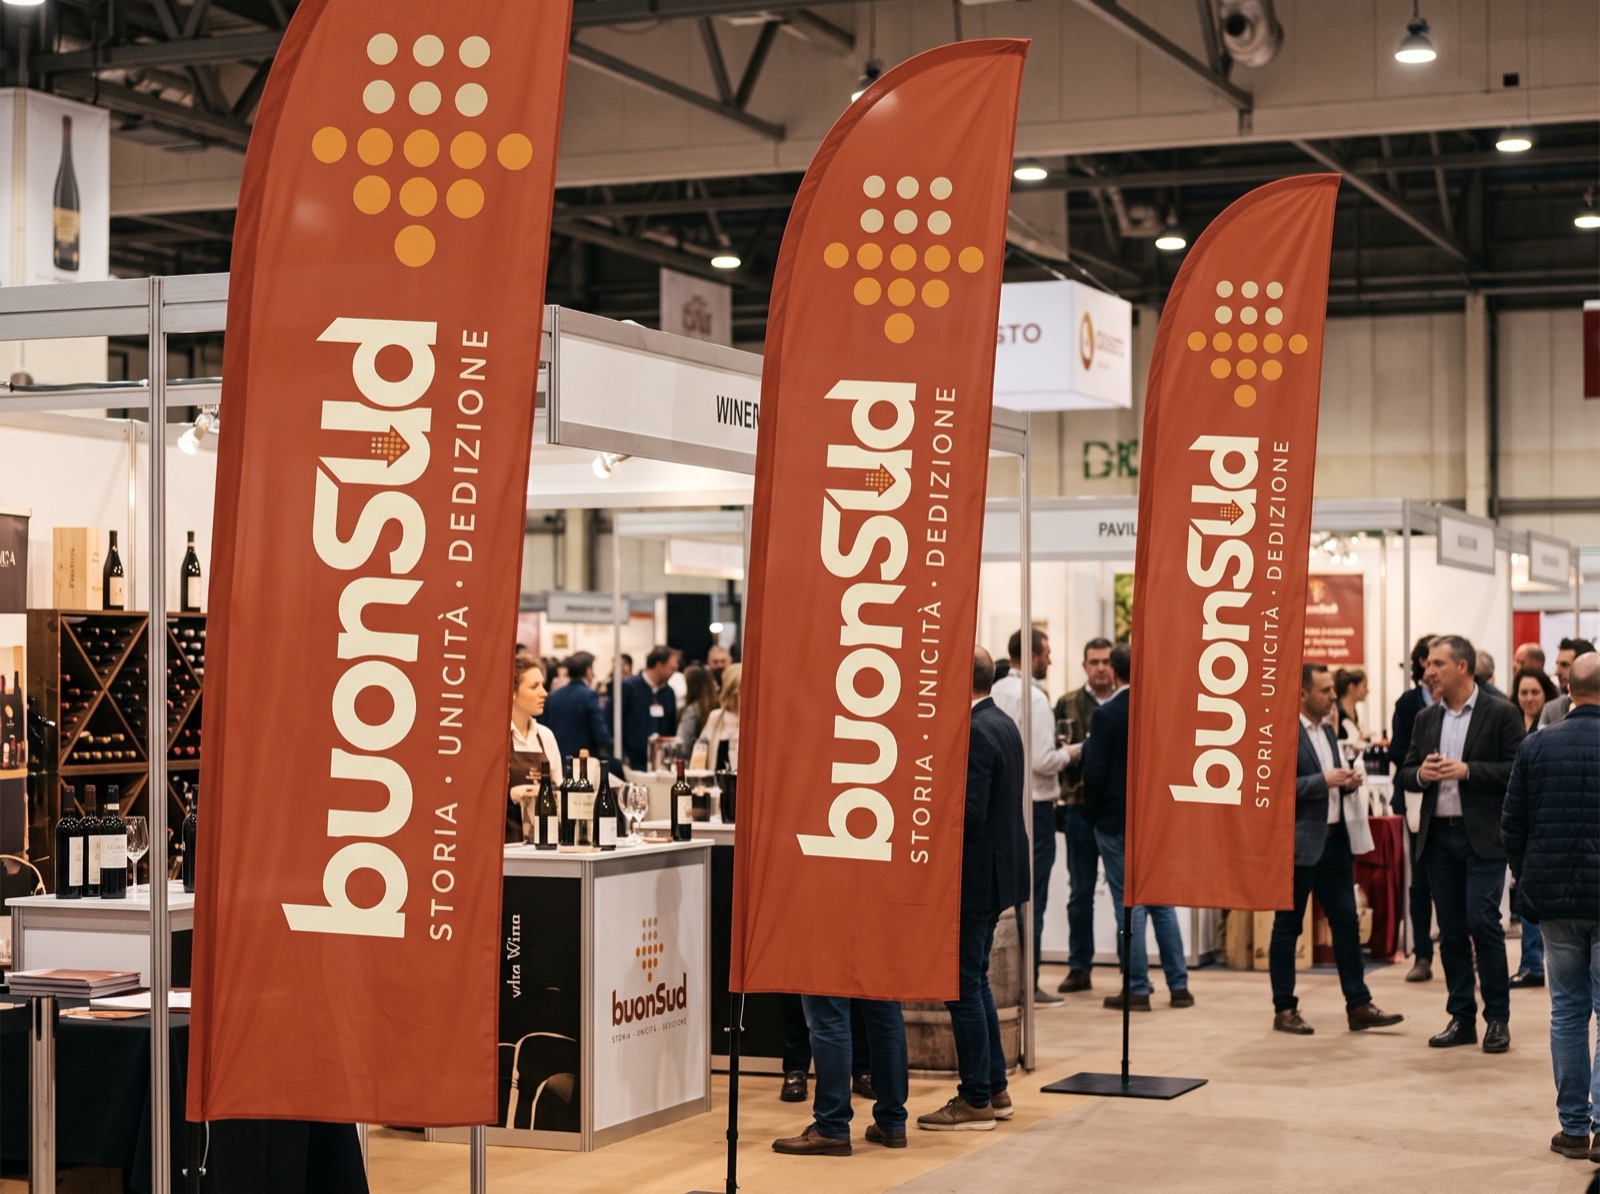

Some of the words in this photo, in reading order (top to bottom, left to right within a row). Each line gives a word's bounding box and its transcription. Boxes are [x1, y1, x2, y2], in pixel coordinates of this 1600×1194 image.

[448, 329, 489, 563] DEDIZIONE
[925, 387, 956, 567] DEDIZIONE
[1266, 441, 1289, 580] DEDIZIONE
[280, 316, 438, 939] buonSud
[437, 605, 469, 755] UNICITÀ
[795, 379, 917, 862] buonSud
[917, 601, 942, 719] UNICITÀ
[1168, 434, 1260, 806] buonSud
[1260, 606, 1280, 697] UNICITÀ
[910, 754, 934, 864] STORIA
[1255, 723, 1273, 808] STORIA
[429, 802, 458, 942] STORIA
[612, 972, 687, 1027] buonSud
